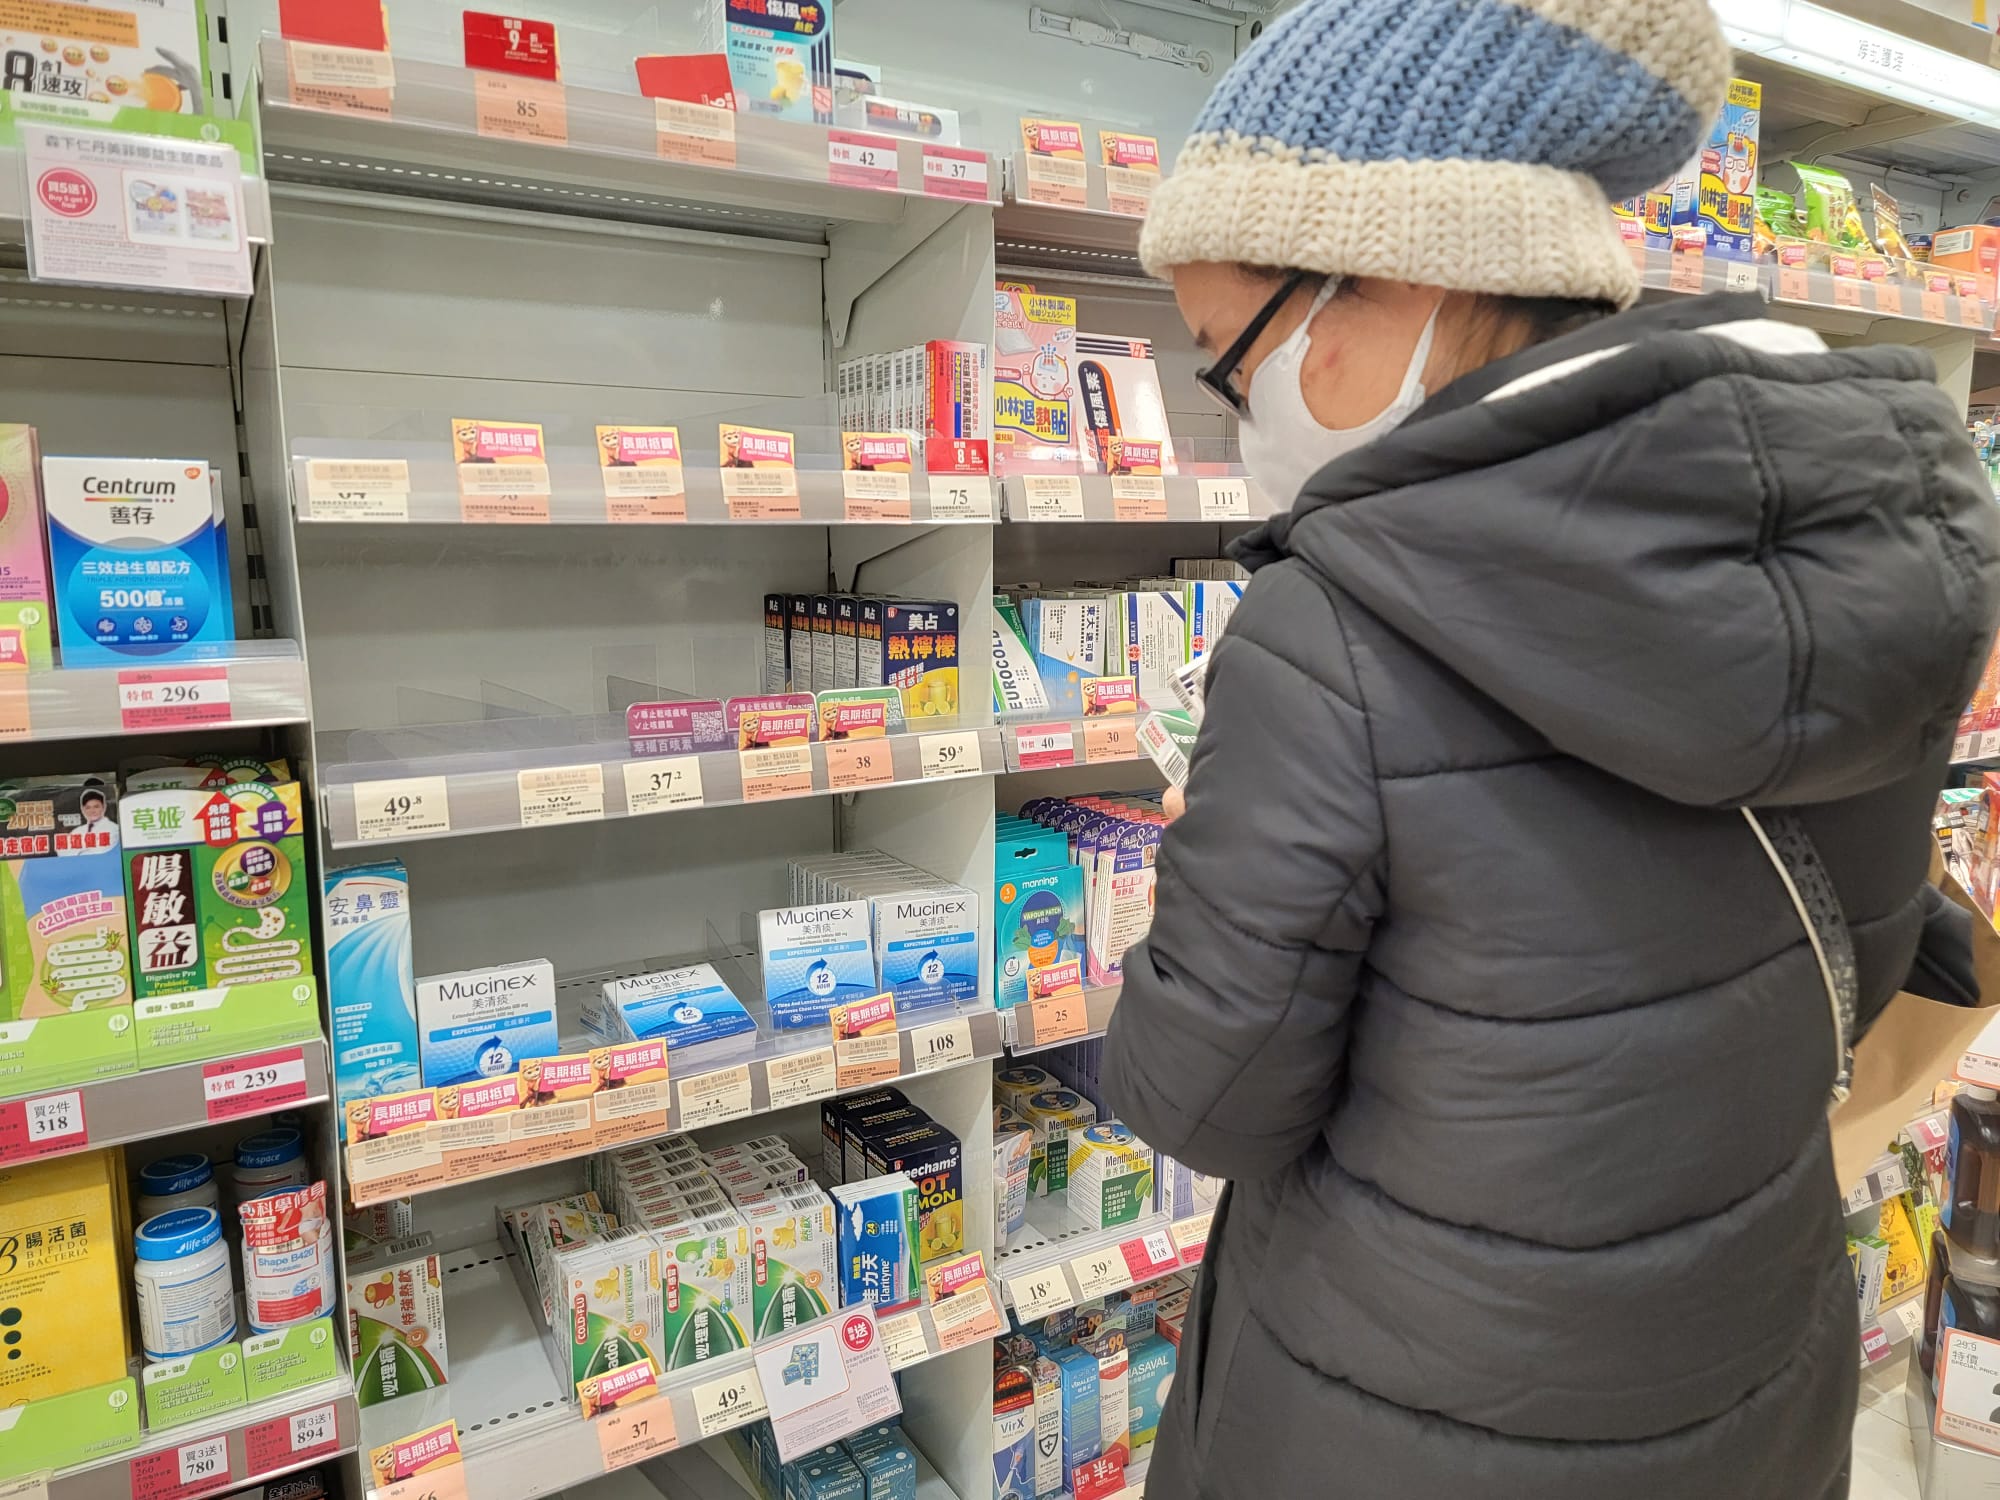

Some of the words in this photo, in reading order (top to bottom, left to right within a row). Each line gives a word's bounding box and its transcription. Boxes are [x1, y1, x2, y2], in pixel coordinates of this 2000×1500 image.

[41, 75, 82, 96] 速攻
[516, 100, 537, 118] 85
[859, 152, 875, 166] 42
[951, 164, 966, 178] 37
[1700, 187, 1751, 230] 小林退熱貼
[995, 395, 1067, 436] 小林退熱貼
[480, 430, 537, 448] 長期抵買
[622, 431, 673, 450] 長期抵買
[742, 437, 788, 454] 長期抵買
[863, 440, 906, 454] 長期抵買
[957, 448, 965, 464] 8
[82, 476, 176, 495] Centrum
[948, 489, 969, 505] 75
[109, 505, 155, 526] 善存
[81, 561, 192, 576] 三效益生菌配方
[816, 601, 827, 615] 美占
[840, 603, 851, 617] 美占
[864, 606, 875, 620] 美占
[907, 613, 938, 631] 美占
[888, 634, 957, 661] 熱檸檬
[161, 685, 200, 702] 296
[1098, 683, 1132, 696] 長期抵買
[840, 707, 882, 722] 長期抵買
[760, 717, 806, 732] 長期抵買
[1041, 737, 1054, 748] 40
[1106, 732, 1119, 743] 30
[855, 756, 871, 769] 38
[938, 745, 963, 763] 59.9
[649, 771, 683, 791] 37.2
[383, 795, 423, 816] 49.8
[131, 805, 186, 831] 草姬
[1022, 876, 1058, 889] mannings
[138, 853, 192, 969] 腸敏益
[329, 890, 400, 918] 安鼻靈
[897, 901, 966, 919] Mucinex
[1045, 905, 1062, 917] PATCH
[776, 907, 853, 926] Mucinex
[802, 924, 832, 935] 美清痰
[927, 964, 938, 973] 12
[619, 969, 700, 991] Mucinex
[816, 973, 829, 983] 12
[439, 973, 537, 1002] Mucinex
[472, 994, 509, 1010] 美清痰
[680, 1009, 694, 1017] 12
[850, 1004, 891, 1022] 長期抵買
[1055, 1010, 1068, 1022] 25
[451, 1023, 497, 1037] EXPECTORANT
[927, 1033, 955, 1054] 108
[489, 1053, 503, 1065] 12
[612, 1048, 661, 1068] 長期抵買
[487, 1064, 505, 1073] HOUR
[543, 1062, 592, 1079] 長期抵買
[243, 1068, 278, 1089] 239
[462, 1084, 516, 1105] 長期抵買
[34, 1101, 71, 1118] 買2件
[374, 1098, 432, 1121] 長期抵買
[35, 1116, 69, 1135] 318
[1048, 1113, 1095, 1131] Mentholatum
[1105, 1147, 1152, 1168] Mentholatum
[902, 1156, 958, 1180] eechams
[916, 1172, 950, 1196] OT
[257, 1180, 327, 1217] 科學修身
[25, 1221, 87, 1249] 腸活菌
[866, 1222, 875, 1234] 24
[26, 1238, 88, 1260] BIFIDO
[27, 1247, 89, 1269] BACTERIA
[257, 1254, 288, 1267] Shape
[290, 1248, 314, 1263] B420
[1151, 1247, 1167, 1260] 118
[862, 1253, 879, 1303] 佳力天
[943, 1261, 981, 1283] 長期抵買
[880, 1260, 892, 1303] Clarityne
[1028, 1280, 1051, 1301] 18.9
[397, 1269, 416, 1326] 特強熱飲
[854, 1321, 868, 1338] 送
[1087, 1314, 1103, 1334] 99
[694, 1311, 710, 1360] 必理痛
[1108, 1333, 1124, 1354] 99
[1951, 1359, 1978, 1371] SPECIAL
[1979, 1367, 1999, 1376] PRICE
[1952, 1351, 1979, 1366] 特價
[379, 1345, 398, 1398] 必理痛
[601, 1368, 650, 1392] 長期抵買
[718, 1385, 747, 1409] 49.5
[296, 1413, 332, 1431] 買3送1
[631, 1421, 649, 1438] 37
[1001, 1417, 1024, 1433] VirX
[1038, 1420, 1059, 1430] SPRAY
[297, 1427, 324, 1445] 894
[185, 1445, 224, 1462] 買3送1
[397, 1432, 452, 1463] 長期抵買
[186, 1458, 215, 1477] 780
[872, 1466, 906, 1483] FLUIMUCIL
